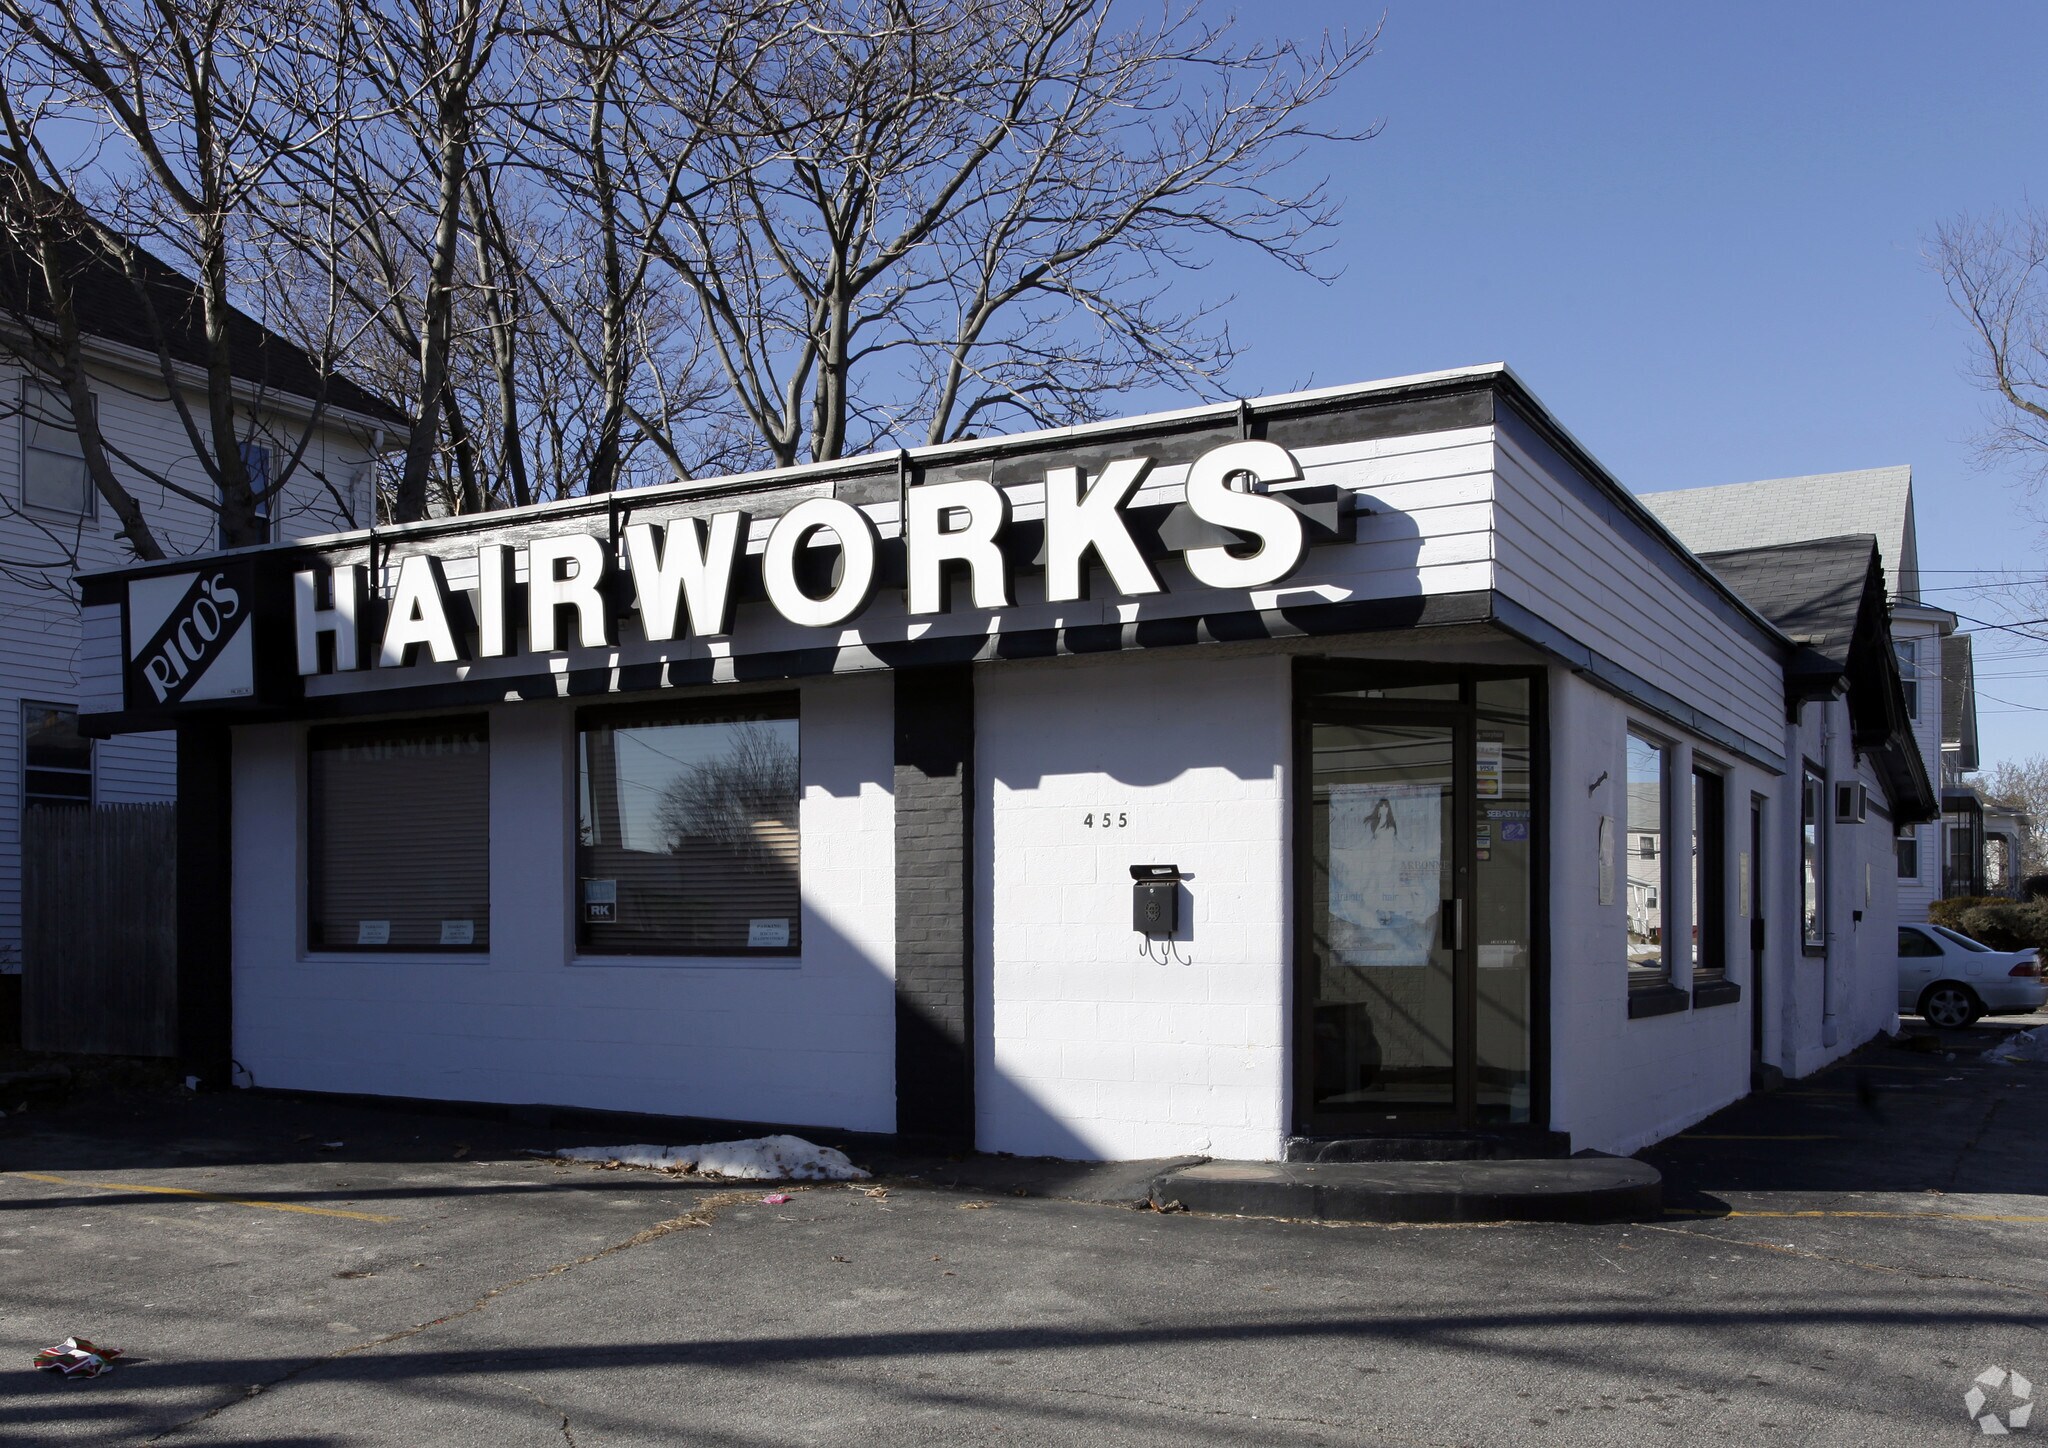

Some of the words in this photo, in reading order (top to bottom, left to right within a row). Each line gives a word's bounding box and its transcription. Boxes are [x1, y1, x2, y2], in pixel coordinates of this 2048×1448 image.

[293, 440, 1306, 676] HAIRWORKS
[143, 572, 240, 704] RICO'S
[1083, 812, 1128, 828] 455
[590, 905, 610, 915] RK
